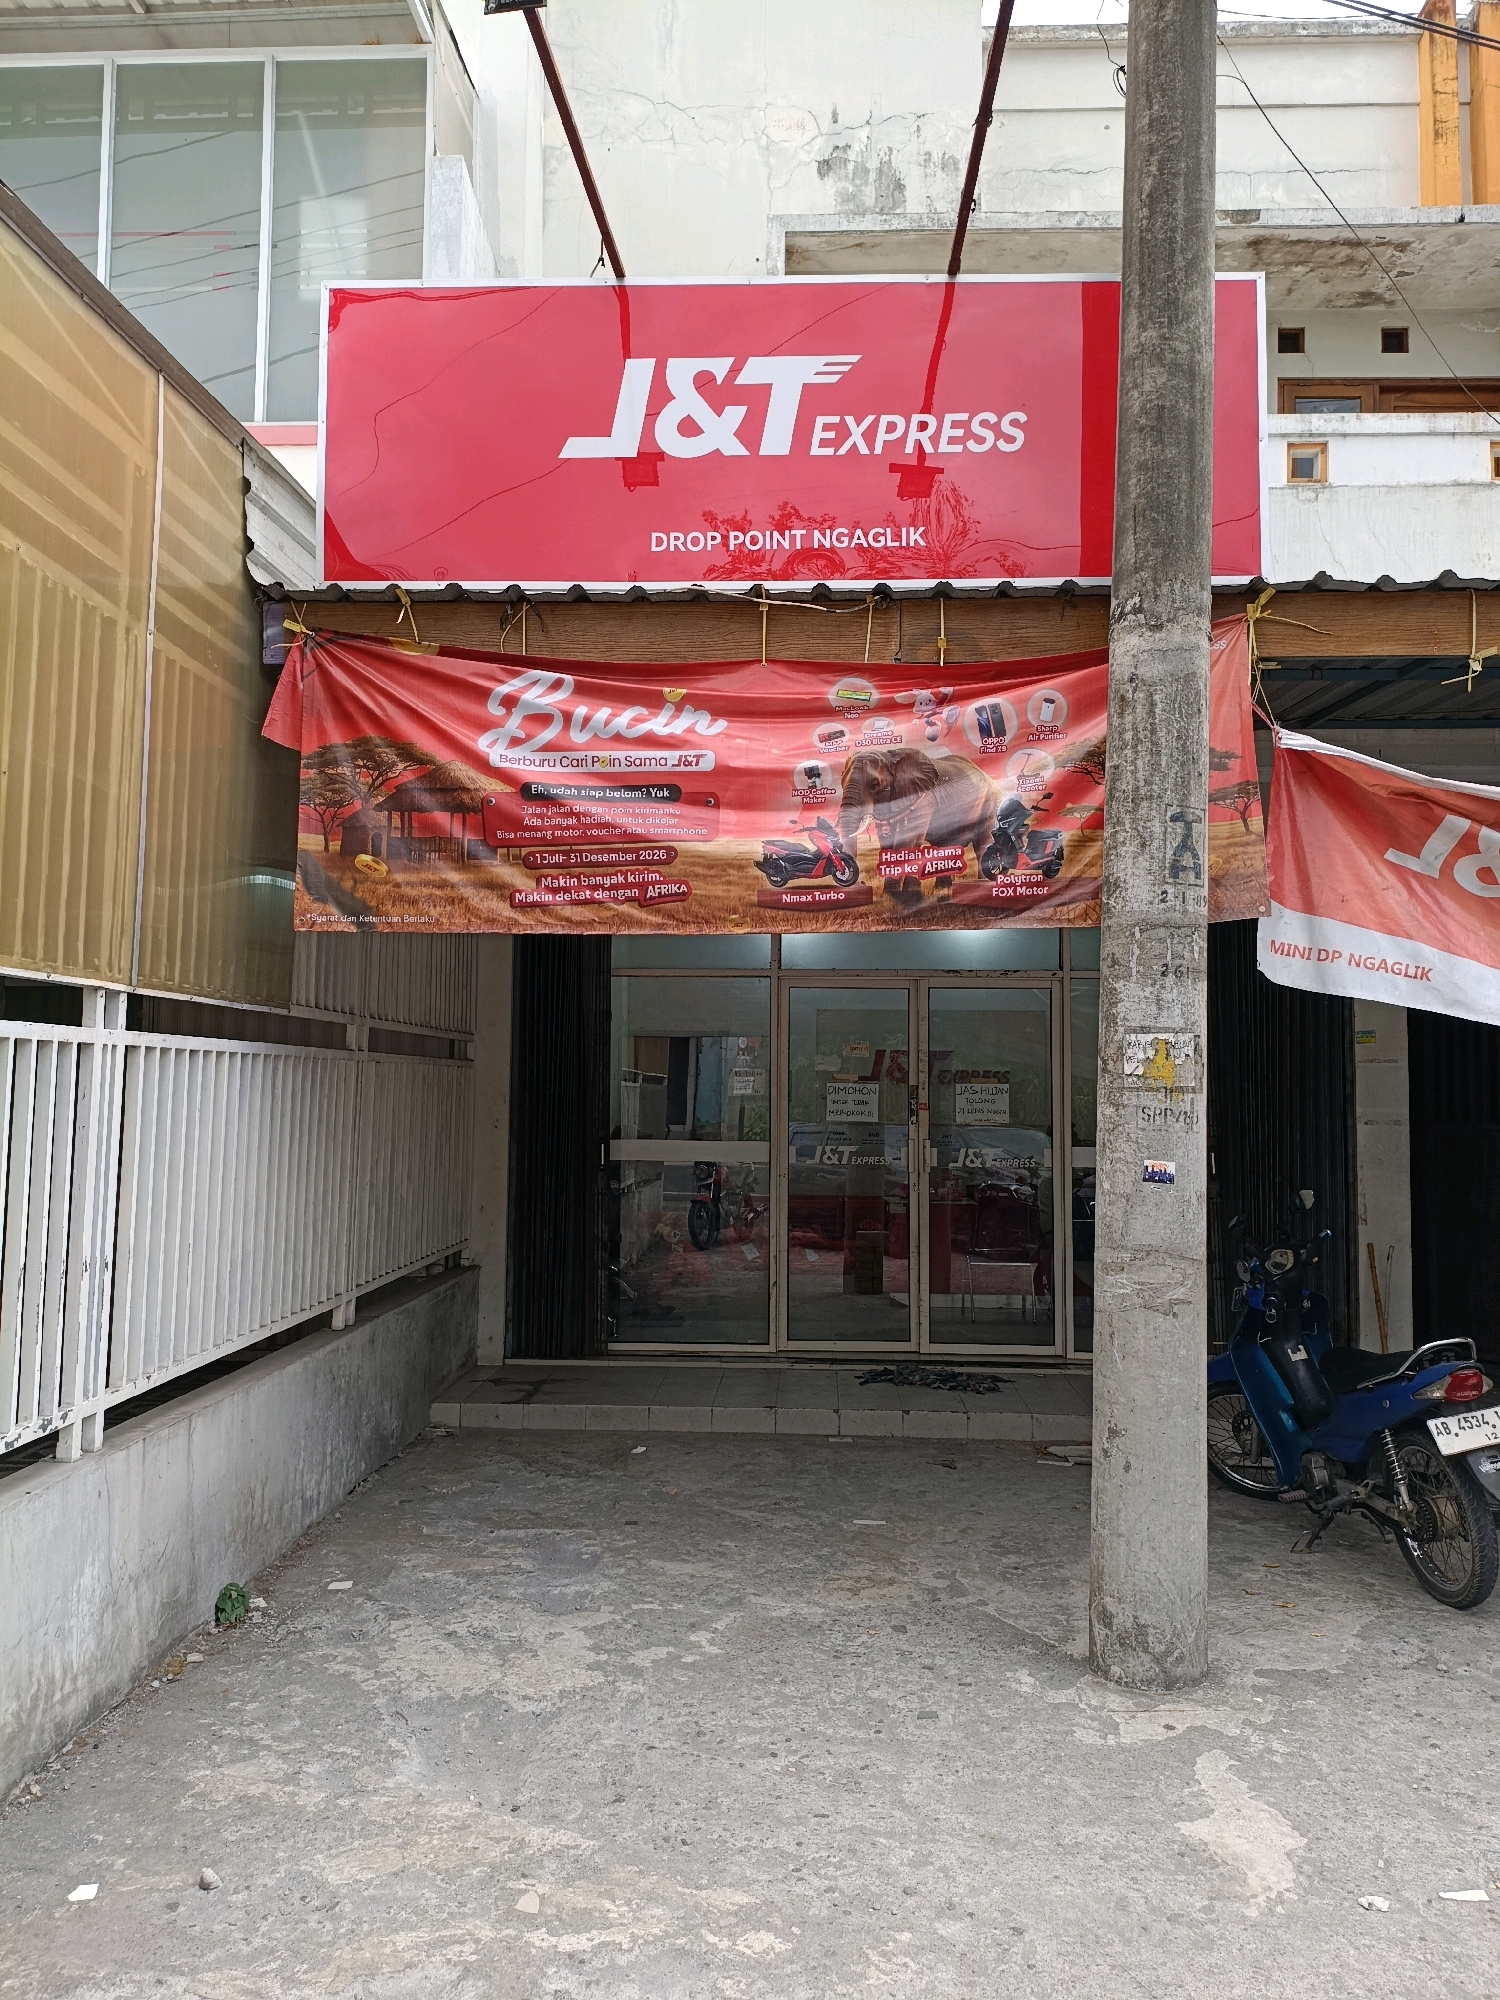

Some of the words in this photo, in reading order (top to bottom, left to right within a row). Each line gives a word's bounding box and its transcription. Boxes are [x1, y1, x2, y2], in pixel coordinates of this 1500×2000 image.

[558, 355, 861, 459] J&T
[809, 411, 1027, 456] EXPRESS
[650, 531, 722, 553] DROP
[728, 529, 806, 551] POINT
[812, 526, 926, 549] NGAGLIK
[477, 670, 728, 754] Bucin
[982, 737, 1005, 745] OPPO
[499, 753, 556, 768] Berburu
[559, 755, 588, 768] Cari
[624, 756, 667, 767] Sama
[671, 753, 706, 767] J&T
[1019, 776, 1044, 785] Xiaomi
[531, 784, 547, 795] Eh,
[550, 787, 577, 796] udah
[581, 788, 603, 798] siap
[650, 787, 669, 797] Yuk
[1017, 784, 1046, 792] Scooter
[521, 805, 546, 814] Jalan
[548, 805, 570, 815] jalan
[573, 803, 608, 814] dengan
[611, 806, 632, 815] poin
[635, 806, 681, 815] kirimanku
[523, 816, 542, 826] Ada
[544, 816, 578, 828] banyak
[581, 815, 614, 825] hadiah,
[616, 816, 643, 824] untuk
[646, 816, 678, 826] dikejar
[497, 830, 514, 839] Bisa
[517, 831, 553, 840] menang
[555, 829, 585, 838] motor,
[586, 827, 625, 836] voucher
[650, 827, 707, 836] smartphone
[569, 853, 581, 863] 31
[583, 852, 637, 862] Desember
[639, 850, 667, 860] 2026
[882, 850, 921, 862] Hadiah
[925, 848, 961, 858] Utama
[880, 864, 902, 876] Trip
[904, 863, 919, 873] ke
[925, 859, 962, 874] AFRIKA
[541, 876, 578, 888] Makin
[581, 872, 625, 888] banyak
[628, 870, 663, 883] kirim.
[997, 873, 1043, 886] Polytron
[515, 890, 552, 903] Makin
[556, 888, 591, 901] dekat
[594, 887, 639, 901] dengan
[646, 883, 687, 899] AFRIKA
[782, 893, 812, 903] Nmax
[814, 891, 845, 902] Turbo
[992, 887, 1013, 897] FOX
[1016, 885, 1048, 896] Motor
[359, 914, 401, 922] Ketentuan
[404, 914, 435, 922] Berlaku
[1270, 940, 1313, 961] MINI
[1317, 948, 1343, 964] DP
[1348, 953, 1434, 982] NGAGLIK
[828, 1086, 876, 1095] DIMOHON
[956, 1086, 978, 1095] JAS
[806, 1146, 860, 1165] J&T
[851, 1156, 890, 1165] EXPRESS
[949, 1147, 1003, 1168] J&T
[995, 1158, 1035, 1168] EXPRESS
